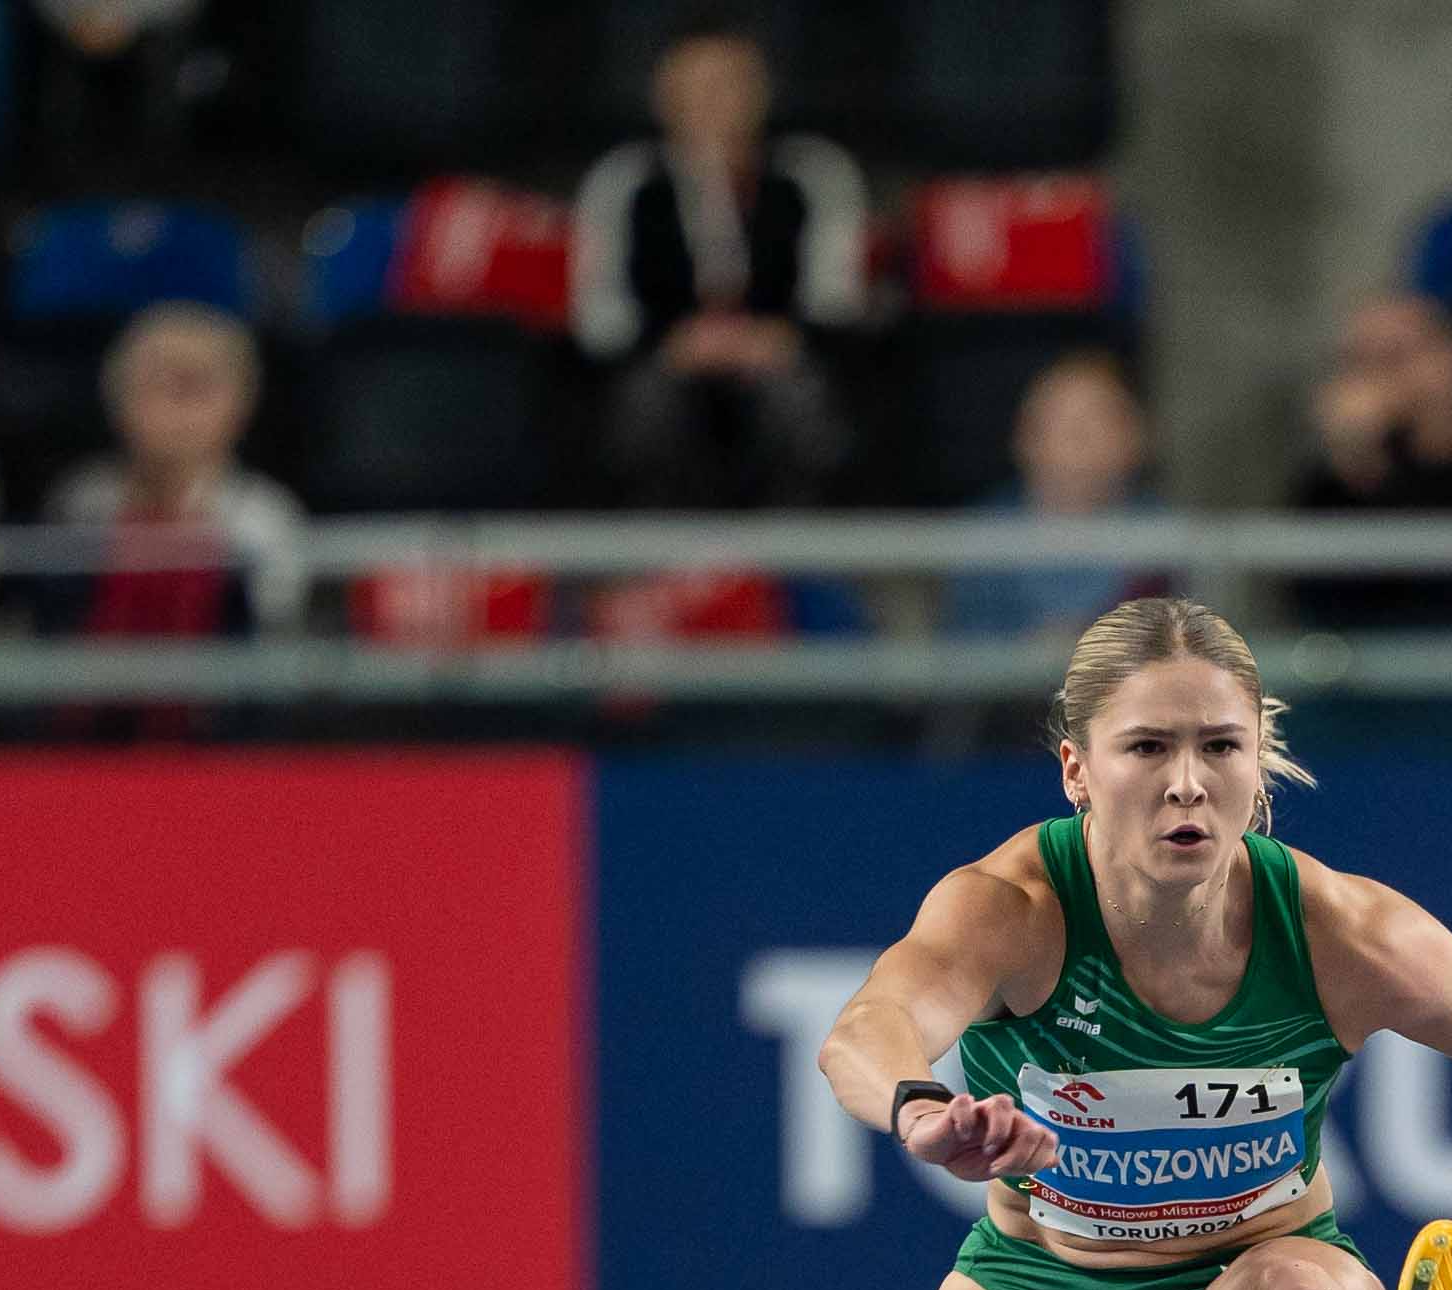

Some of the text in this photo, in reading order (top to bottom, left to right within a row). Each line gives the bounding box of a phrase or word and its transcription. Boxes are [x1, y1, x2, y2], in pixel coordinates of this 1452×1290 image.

[1056, 1016, 1101, 1036] erima
[1174, 1083, 1277, 1119] 171
[1048, 1110, 1115, 1128] ORLEN
[1051, 1131, 1298, 1186] KRZYSZOWSKA
[1040, 1187, 1061, 1204] 68.
[1100, 1208, 1158, 1221] Halowe
[1093, 1213, 1246, 1239] TORUŃ 2024
